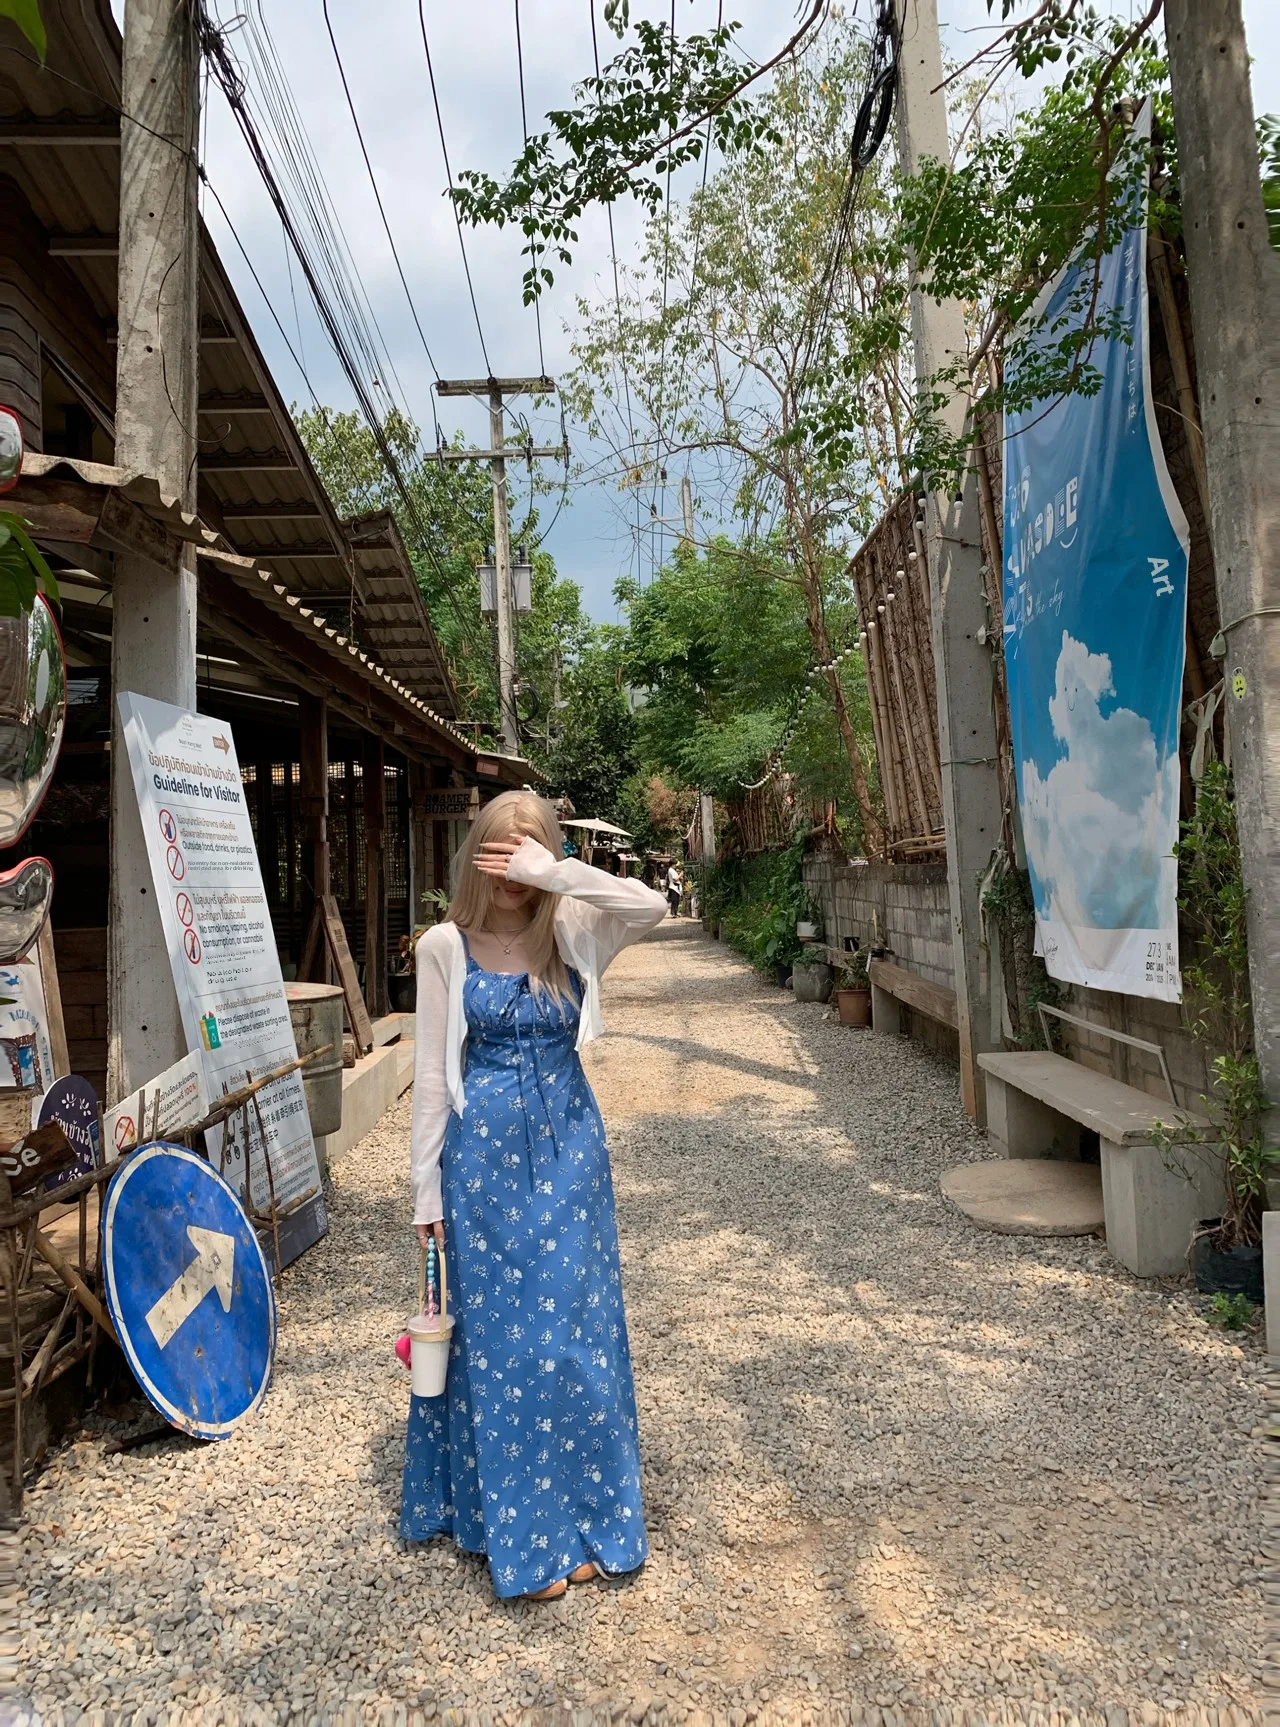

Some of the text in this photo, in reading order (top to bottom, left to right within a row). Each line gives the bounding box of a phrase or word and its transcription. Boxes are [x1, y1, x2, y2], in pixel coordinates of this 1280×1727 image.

[1147, 557, 1175, 597] Art
[153, 773, 240, 803] Guideline for Visitor
[425, 803, 467, 814] BURGER
[182, 841, 202, 851] Outside
[199, 925, 207, 933] No
[248, 921, 264, 930] alcohol
[202, 936, 236, 948] consumption,
[217, 1018, 232, 1026] Please
[232, 1012, 250, 1024] dispose
[249, 1010, 255, 1019] of
[254, 1008, 266, 1016] waste
[220, 1030, 228, 1038] the
[228, 1023, 252, 1036] designated
[252, 1021, 264, 1029] waste
[264, 1017, 279, 1027] sorting
[184, 1083, 197, 1096] 100%
[257, 1096, 272, 1110] arrier
[272, 1092, 279, 1102] at
[278, 1089, 286, 1100] all
